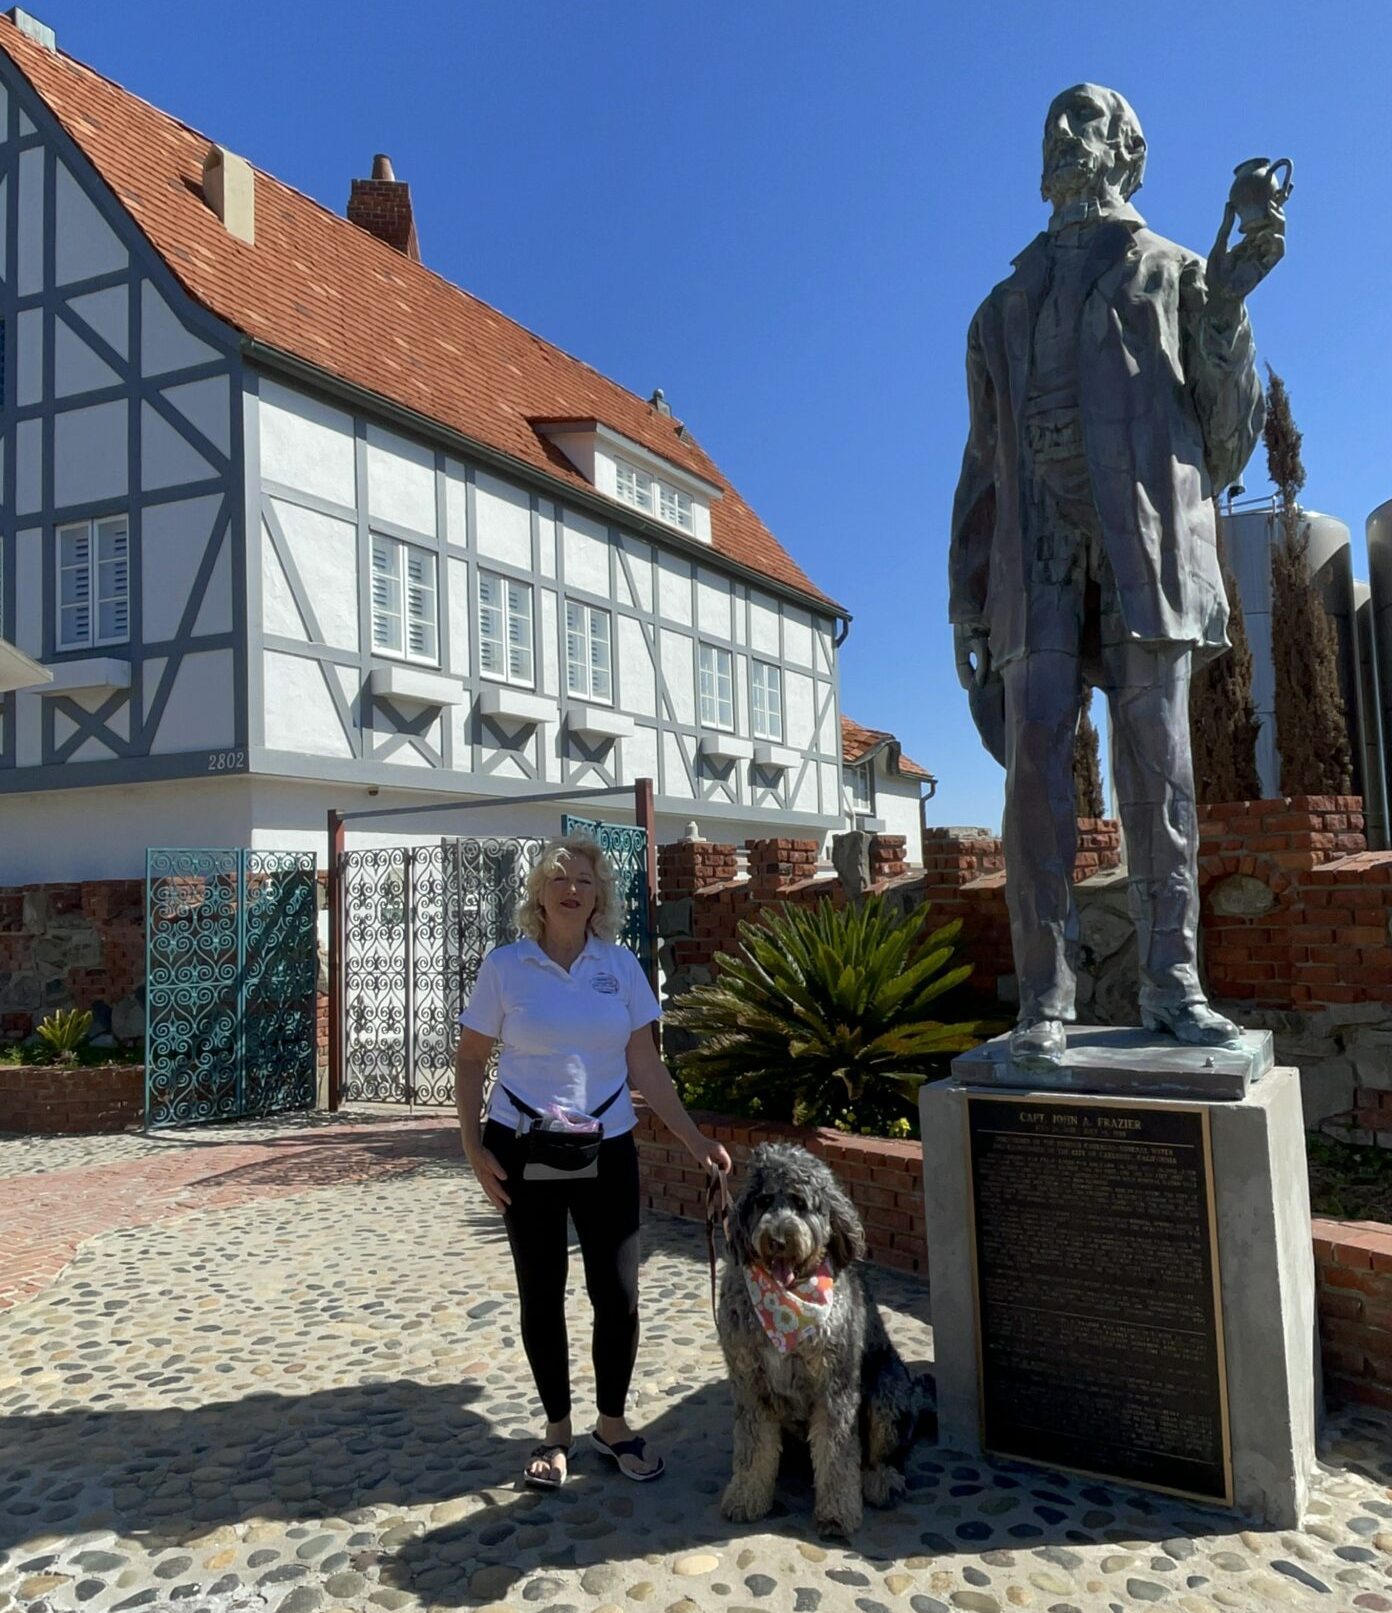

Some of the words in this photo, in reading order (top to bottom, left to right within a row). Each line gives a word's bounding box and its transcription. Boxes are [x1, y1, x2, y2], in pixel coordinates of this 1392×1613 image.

[208, 752, 244, 770] 2802
[1052, 1114, 1078, 1125] JOHN
[1097, 1117, 1142, 1130] FRAZIER
